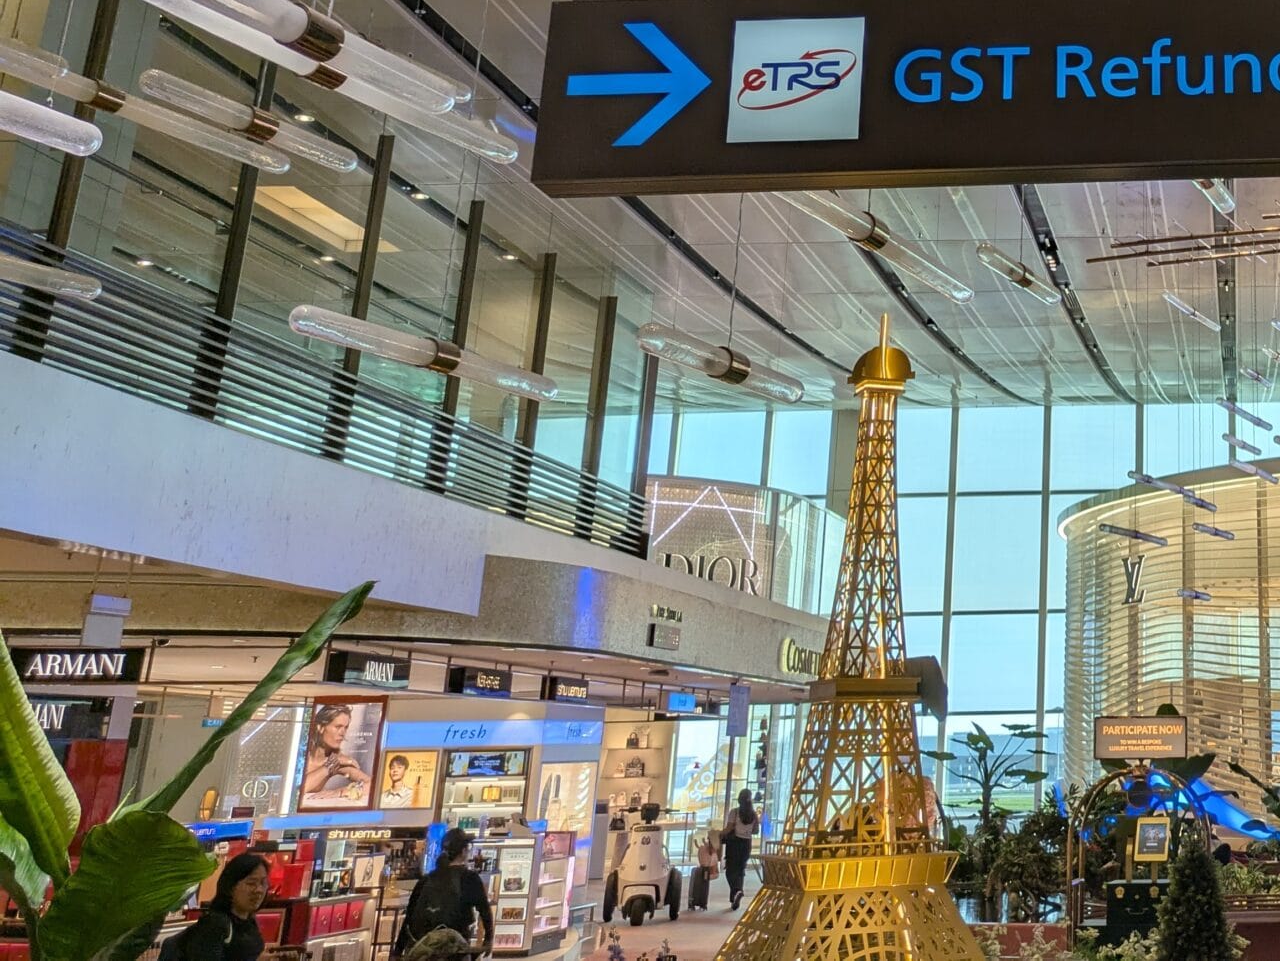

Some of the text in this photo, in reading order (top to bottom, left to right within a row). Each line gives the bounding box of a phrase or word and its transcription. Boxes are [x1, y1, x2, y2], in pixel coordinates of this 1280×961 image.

[743, 60, 841, 92] eTRS
[894, 45, 1030, 103] GST
[25, 653, 126, 677] ARMANI
[444, 724, 487, 742] fresh
[1103, 725, 1183, 735] PARTICIPATE NOW
[328, 829, 349, 839] shu
[350, 829, 392, 839] uemura
